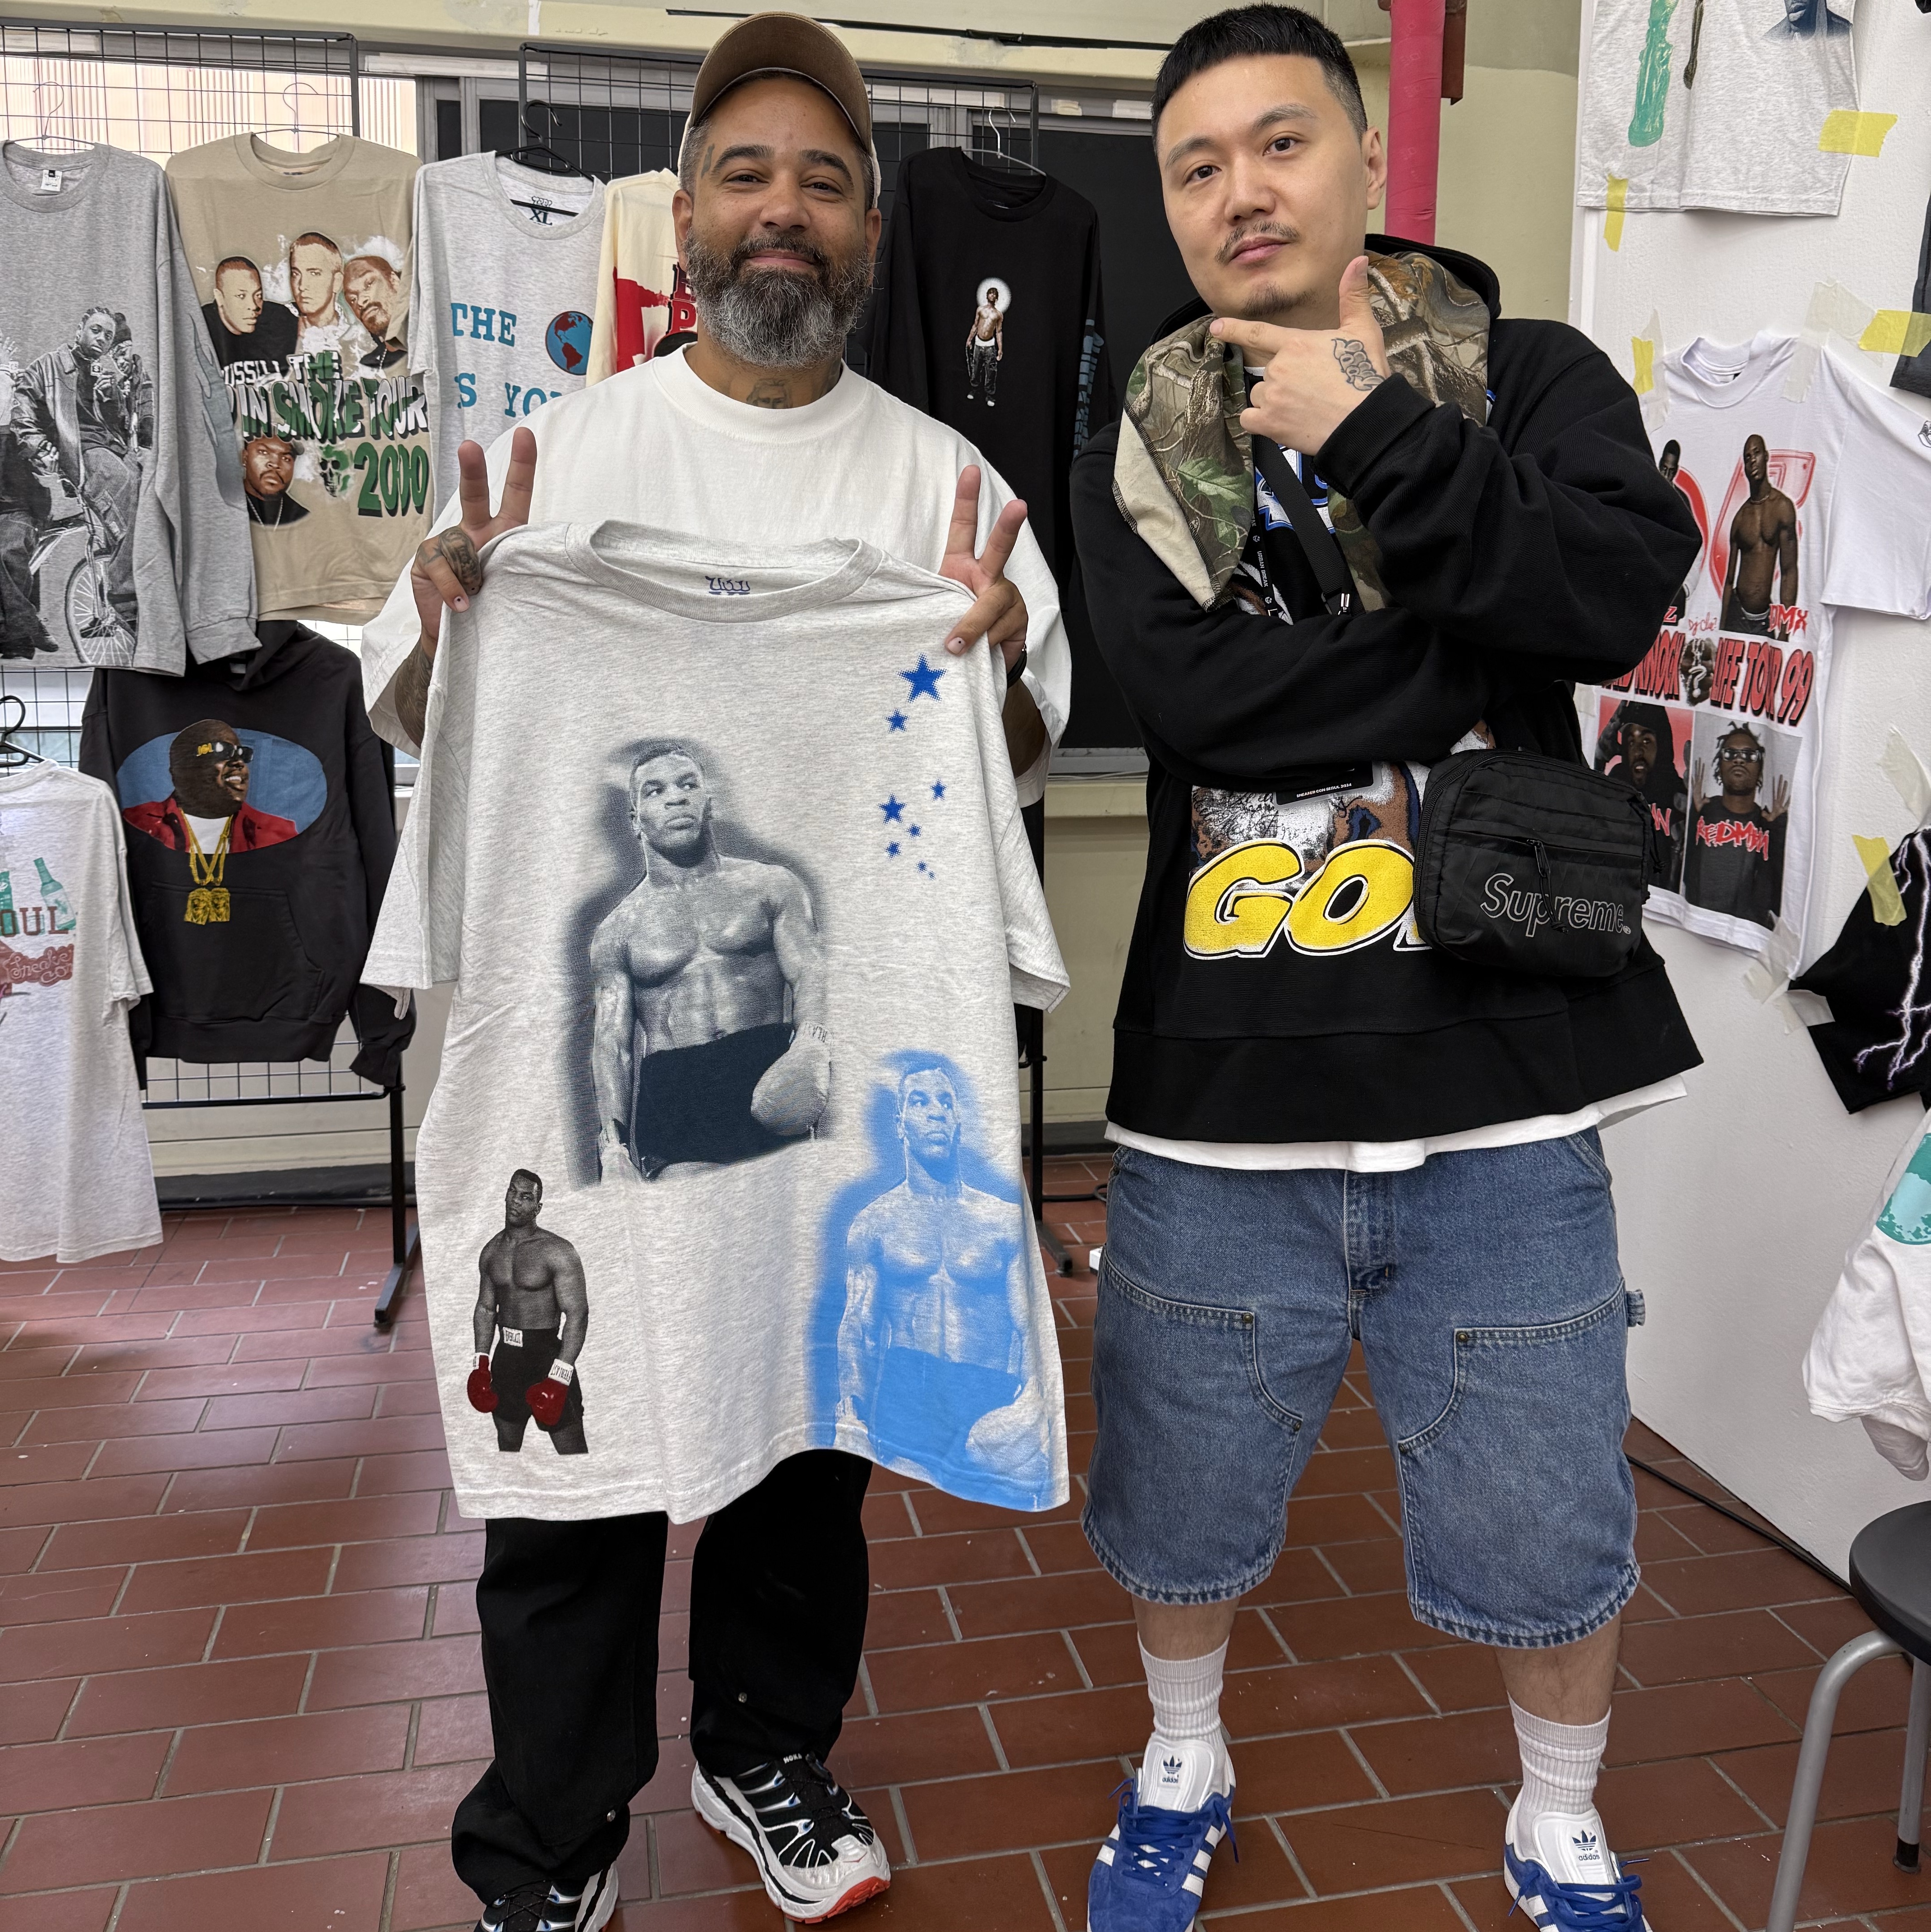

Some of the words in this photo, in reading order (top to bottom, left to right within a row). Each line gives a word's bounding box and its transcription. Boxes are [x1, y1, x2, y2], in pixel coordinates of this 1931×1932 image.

[451, 303, 517, 347] THE
[286, 350, 342, 381] THE
[271, 380, 365, 444] SMOKE
[361, 375, 430, 441] TOUR
[505, 382, 562, 417] YO
[354, 442, 429, 517] 2000
[1767, 603, 1809, 638] DMX
[1710, 637, 1745, 711] LIFE
[1739, 641, 1783, 721] TOUR
[1777, 648, 1814, 728] 99
[1480, 872, 1624, 937] Supreme
[10, 949, 72, 979] Sneake
